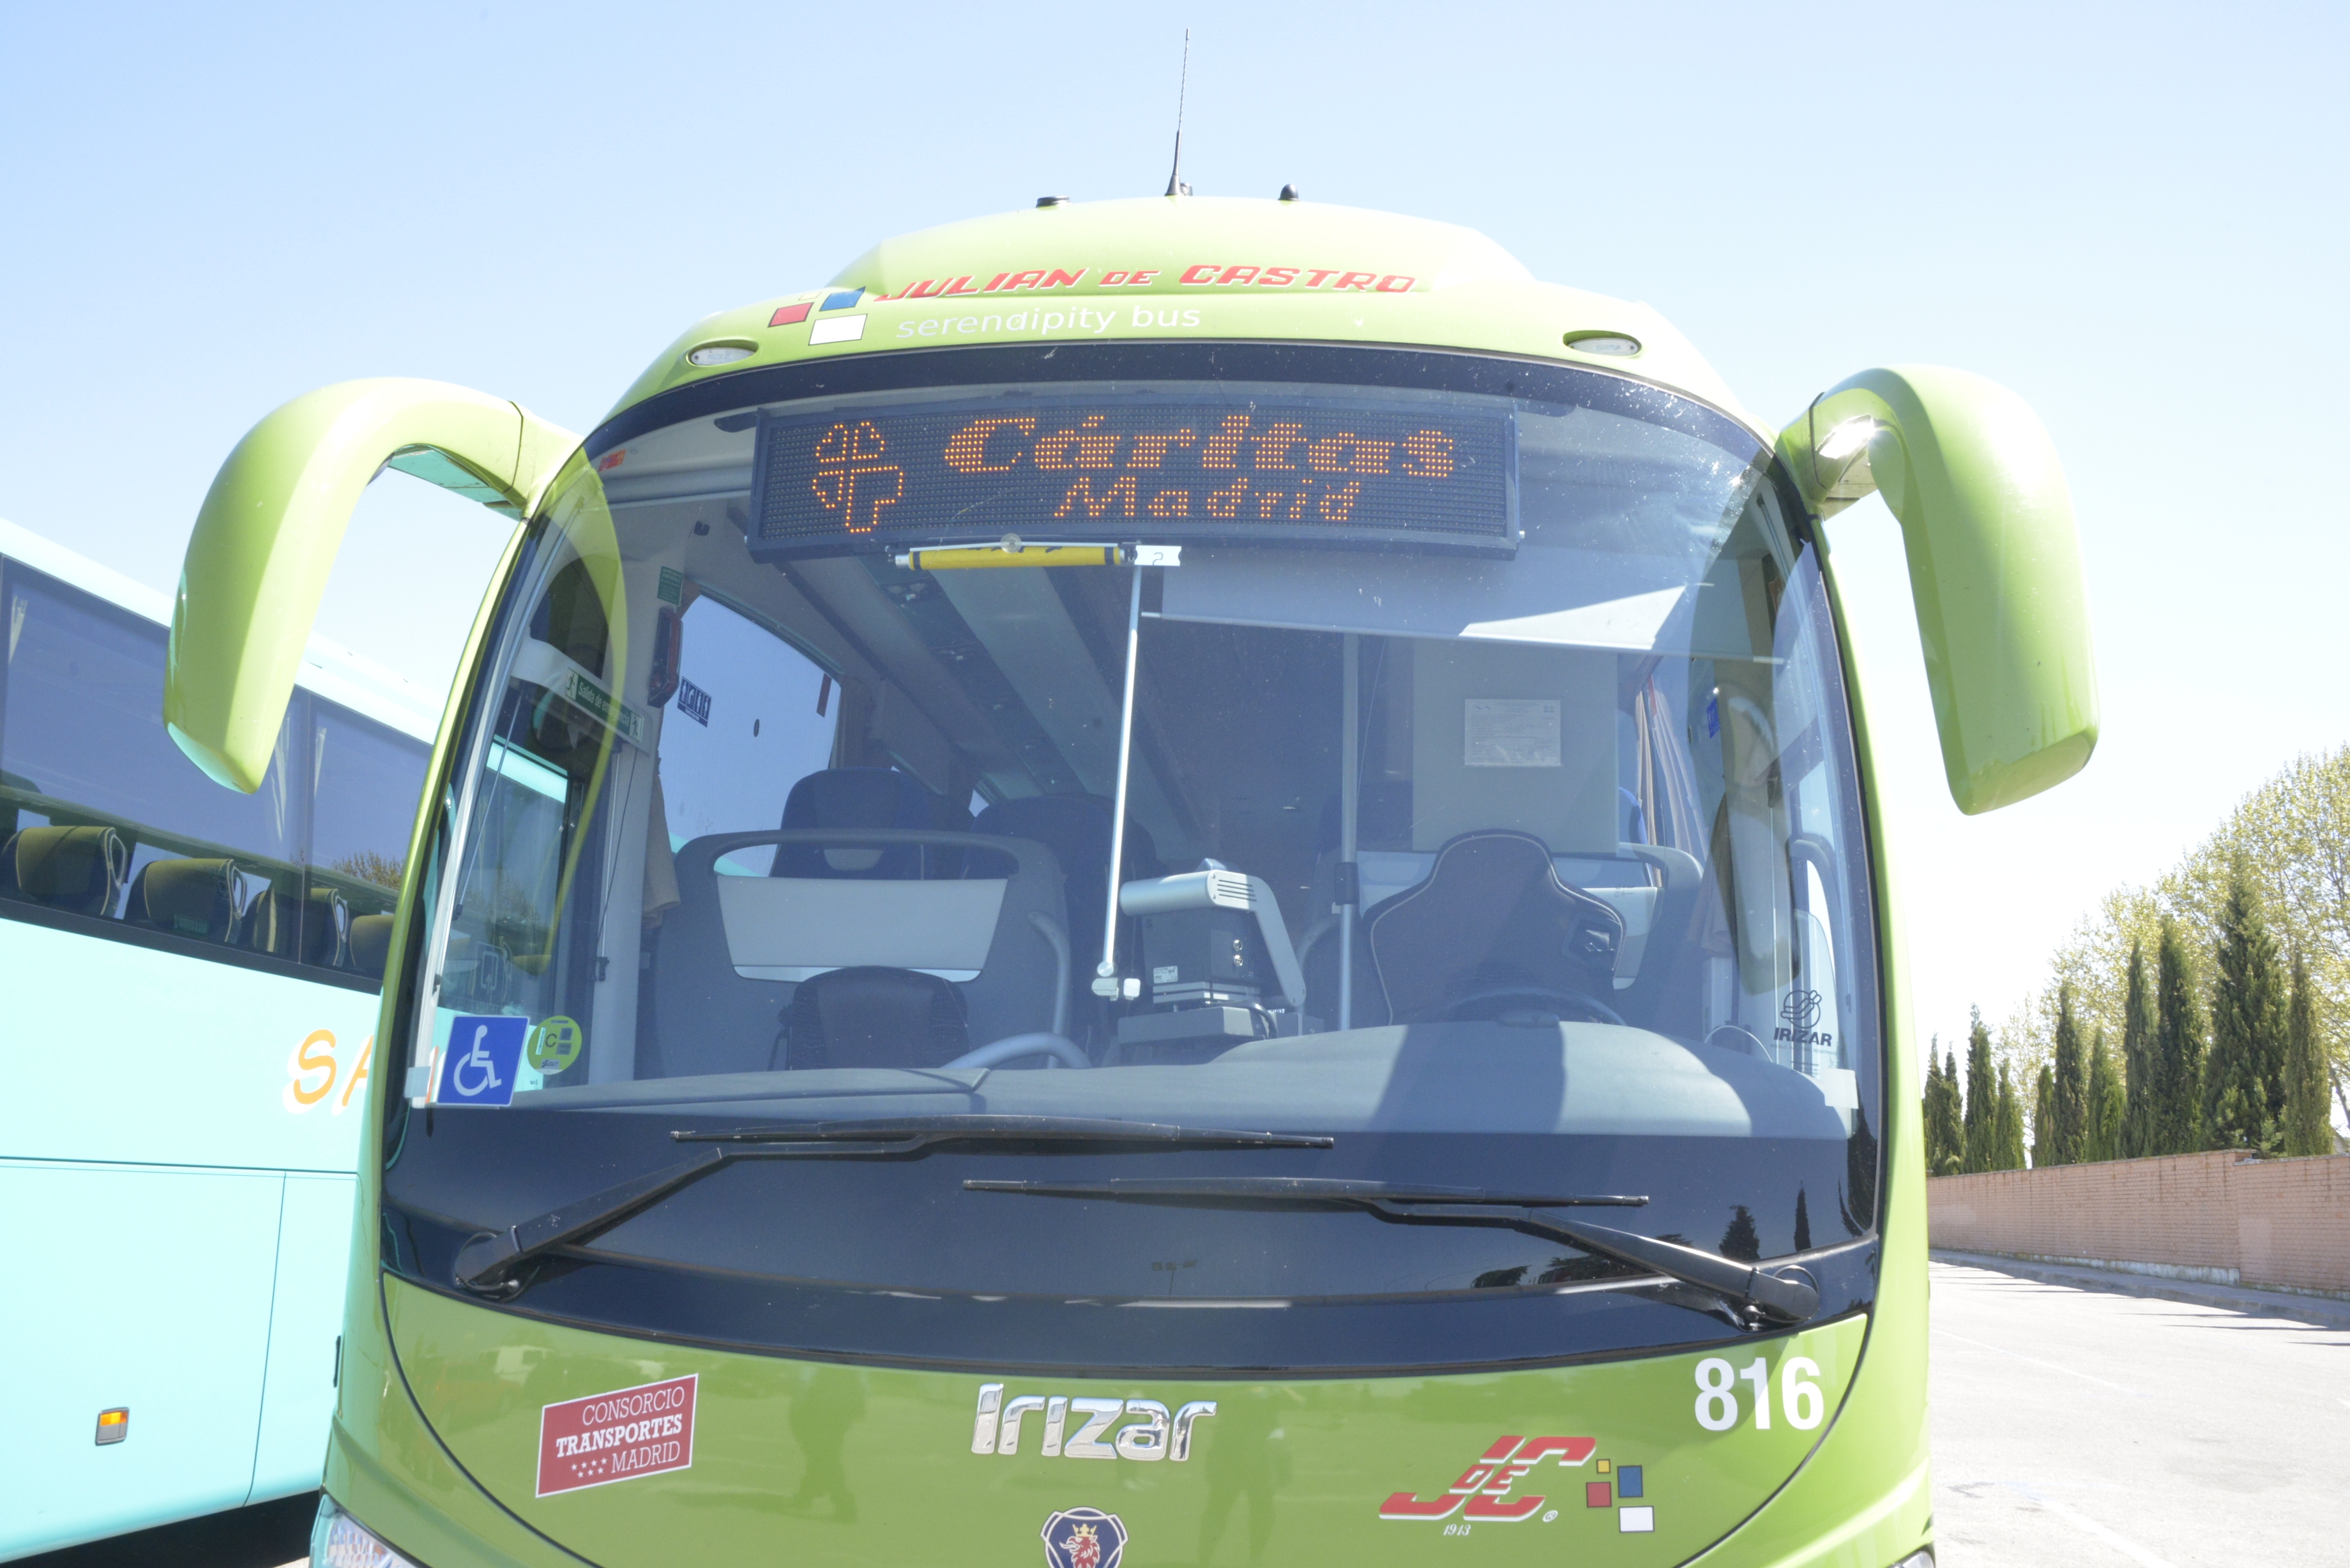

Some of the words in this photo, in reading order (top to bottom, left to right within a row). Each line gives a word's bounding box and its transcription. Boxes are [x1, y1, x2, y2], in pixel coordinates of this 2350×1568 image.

[874, 267, 1089, 303] JULIAN
[1099, 270, 1161, 287] DE
[1179, 264, 1418, 294] CASTRO
[897, 306, 1117, 338] serendipity
[1132, 305, 1201, 327] bus
[944, 415, 1453, 478] Cáritas
[1054, 477, 1360, 520] Madrid
[577, 682, 595, 704] Salida
[595, 694, 602, 708] de
[545, 1033, 557, 1048] C
[1773, 1027, 1832, 1047] IRIZAR
[582, 1386, 685, 1426] CONSORCIO
[1695, 1357, 1824, 1431] 816
[556, 1413, 683, 1458] TRANSPORTES
[610, 1440, 680, 1474] MADRID
[1442, 1523, 1471, 1537] 1913
